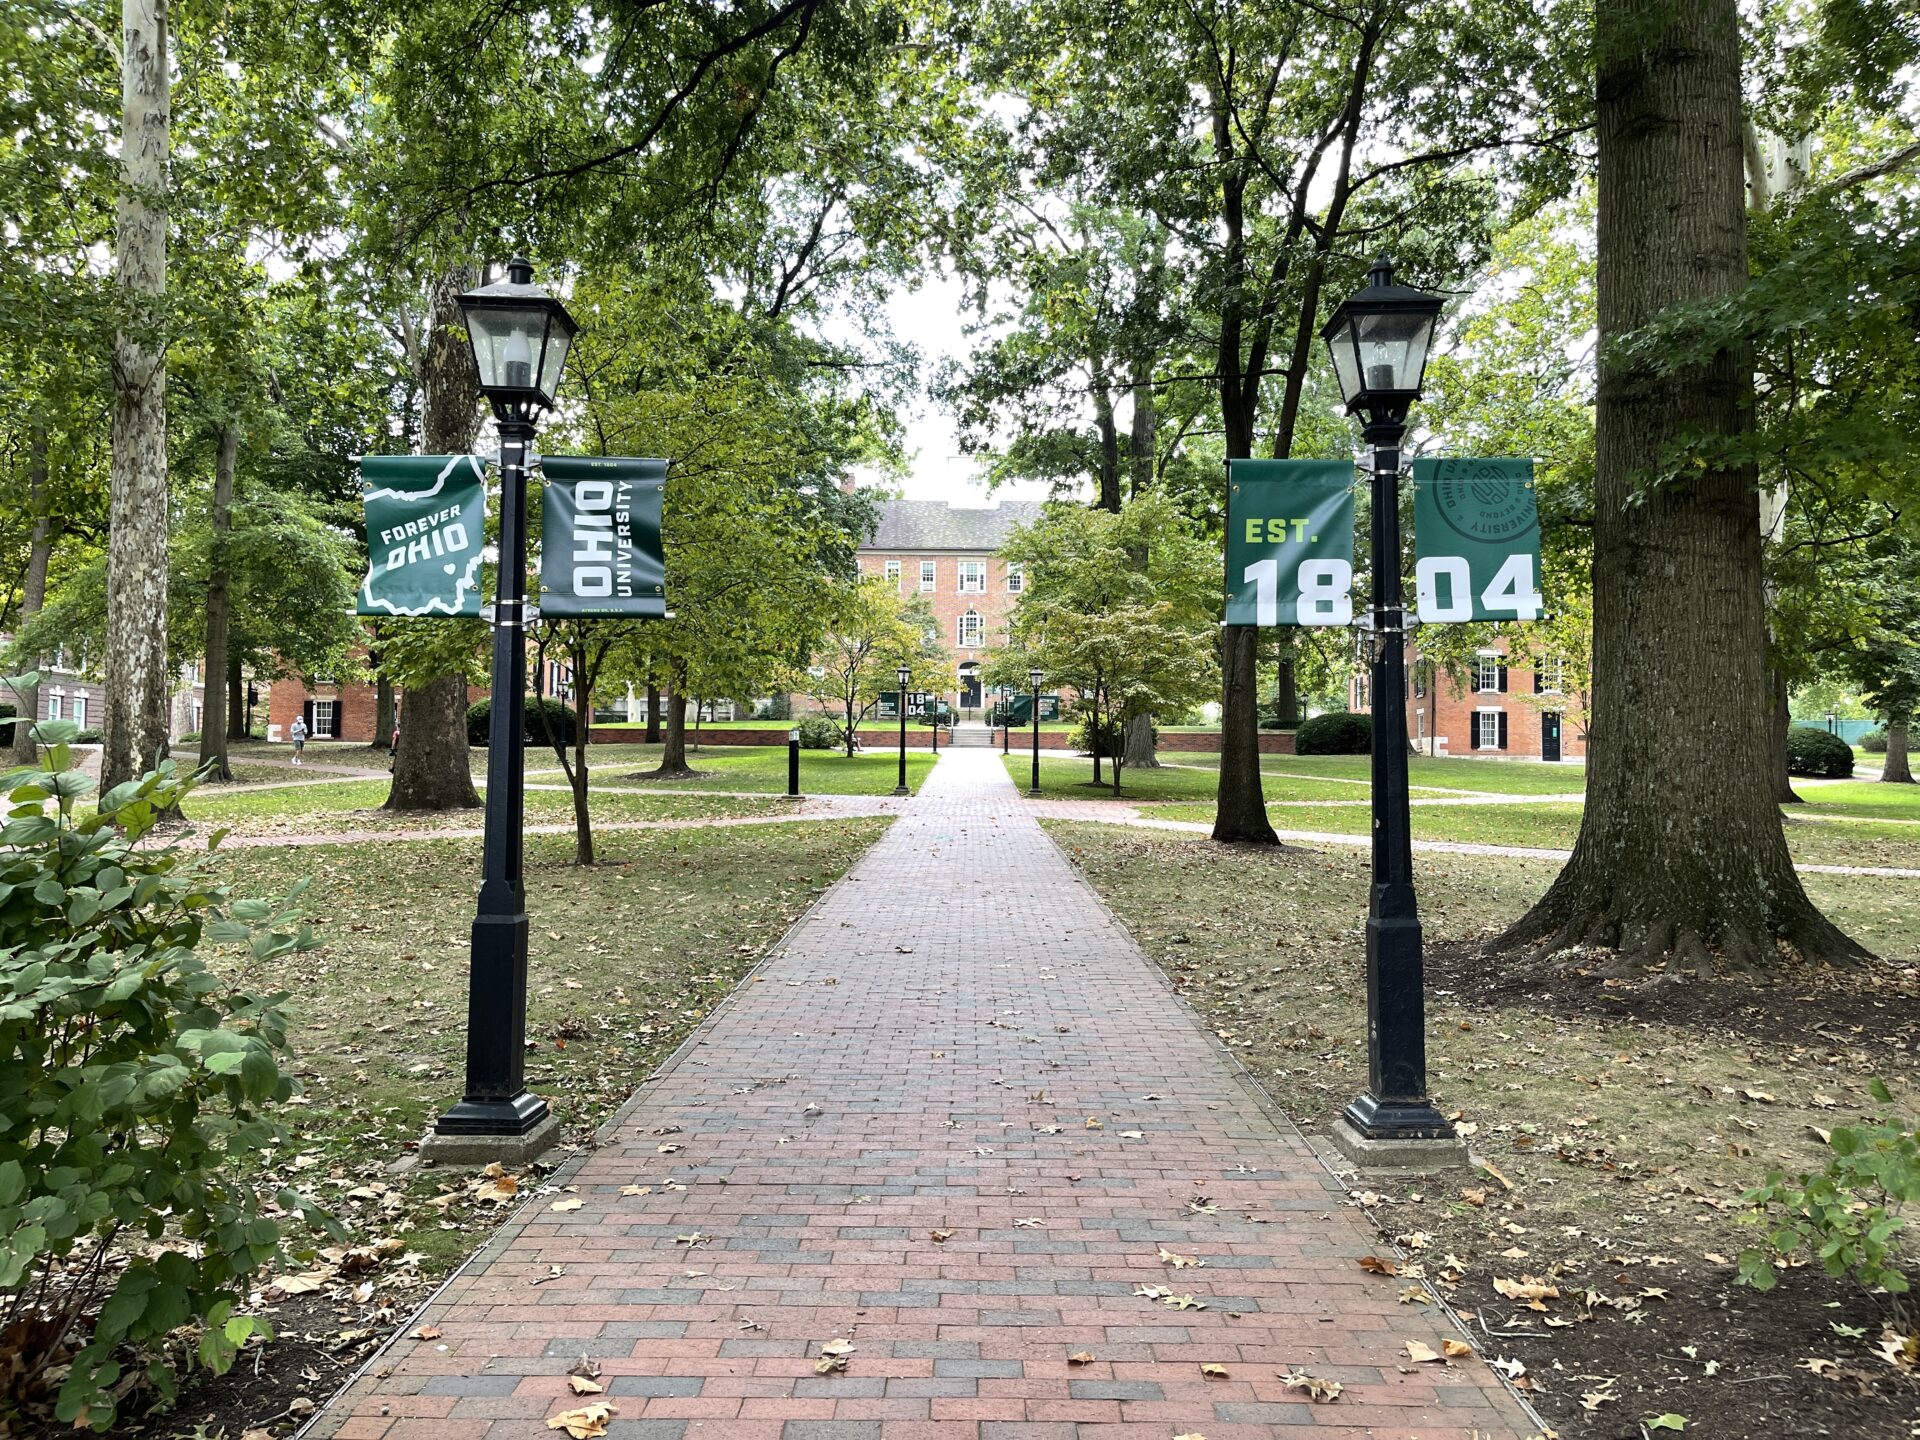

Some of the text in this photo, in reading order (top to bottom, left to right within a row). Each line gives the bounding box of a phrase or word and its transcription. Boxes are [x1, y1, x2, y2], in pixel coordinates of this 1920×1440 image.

[380, 504, 462, 546] FOREVER
[1245, 518, 1319, 544] EST.
[1470, 498, 1537, 534] UNIVERSITY
[1479, 504, 1517, 518] BEYOND
[386, 522, 469, 571] OHIO
[573, 480, 614, 597] OHIO
[616, 480, 634, 597] UNIVERSITY
[1243, 558, 1353, 627] 18
[1415, 553, 1543, 623] 04
[908, 694, 925, 704] 18
[908, 705, 926, 715] 04
